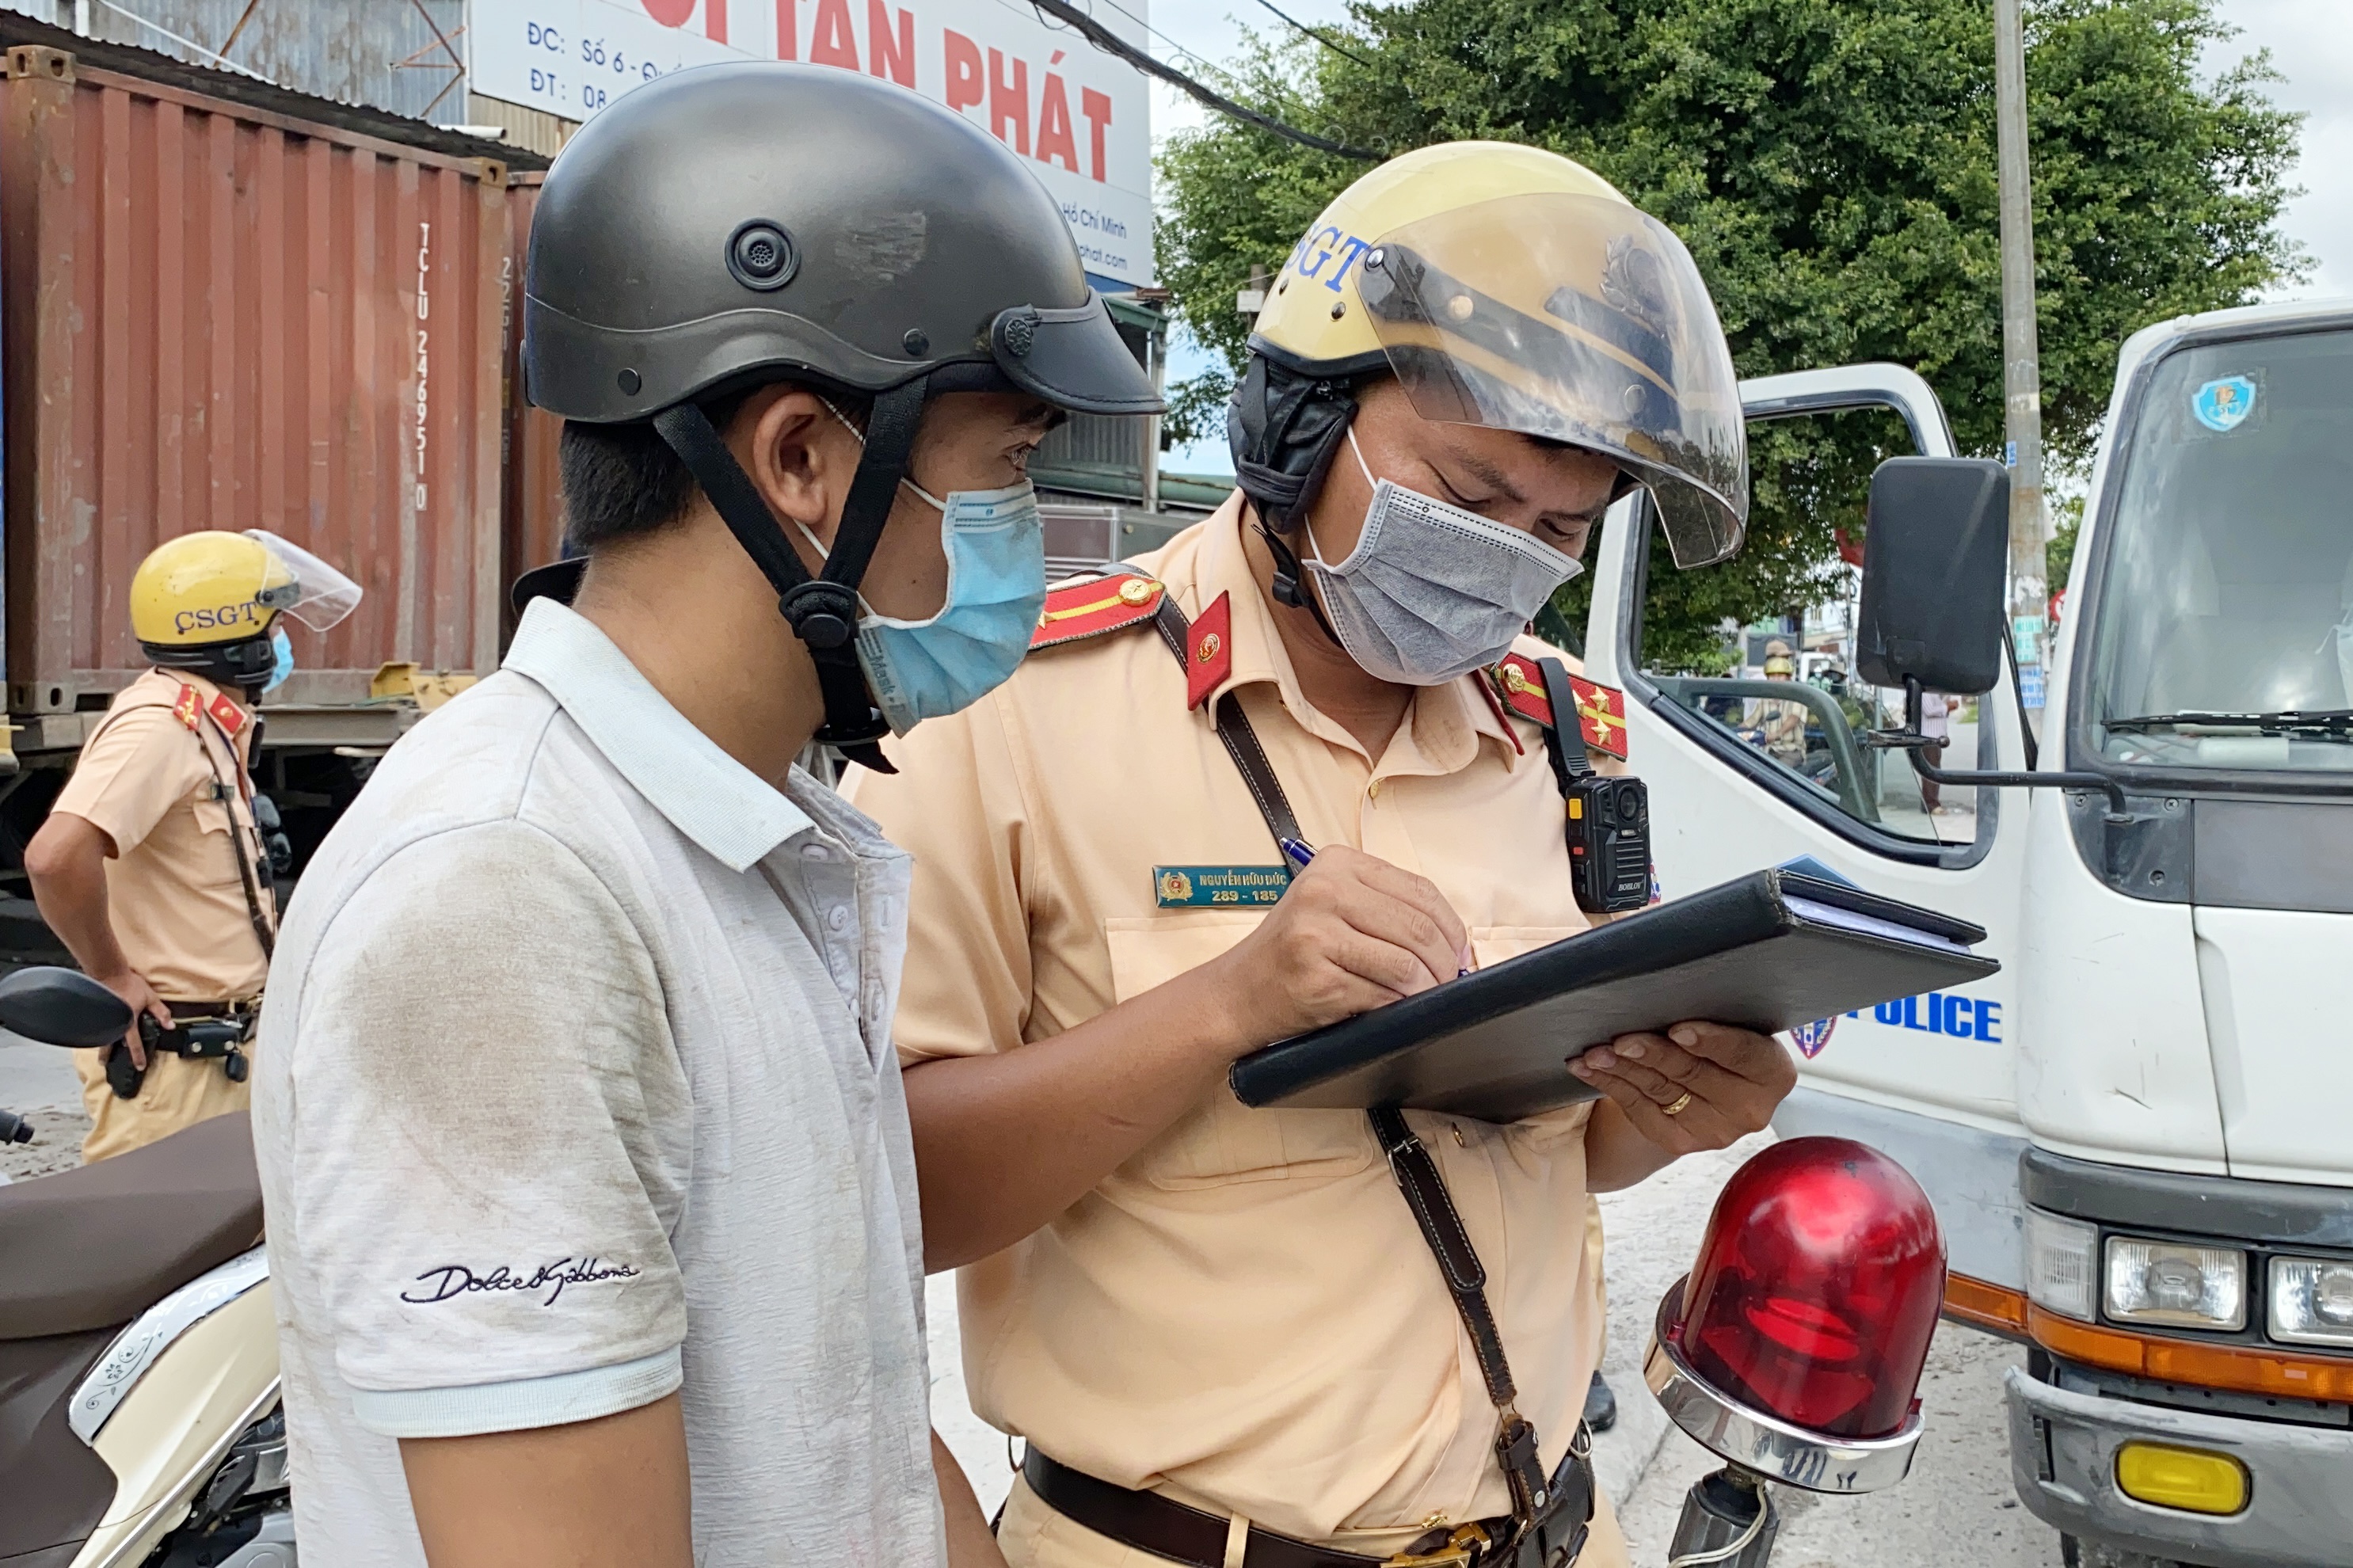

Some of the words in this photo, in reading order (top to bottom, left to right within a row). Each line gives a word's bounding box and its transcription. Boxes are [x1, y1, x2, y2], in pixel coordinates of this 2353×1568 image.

[527, 21, 565, 54] ĐC:
[581, 38, 606, 66] Số
[613, 51, 624, 73] 6
[943, 27, 1112, 184] PHÁT
[1102, 215, 1127, 239] Minh
[175, 601, 257, 631] CSGT
[1199, 869, 1241, 886] NGUYỄN
[1242, 871, 1264, 886] HỮU
[1265, 871, 1287, 886] ĐỨC
[1212, 890, 1239, 902] 289
[1252, 890, 1279, 902] 185
[1846, 992, 2003, 1045] OLICE
